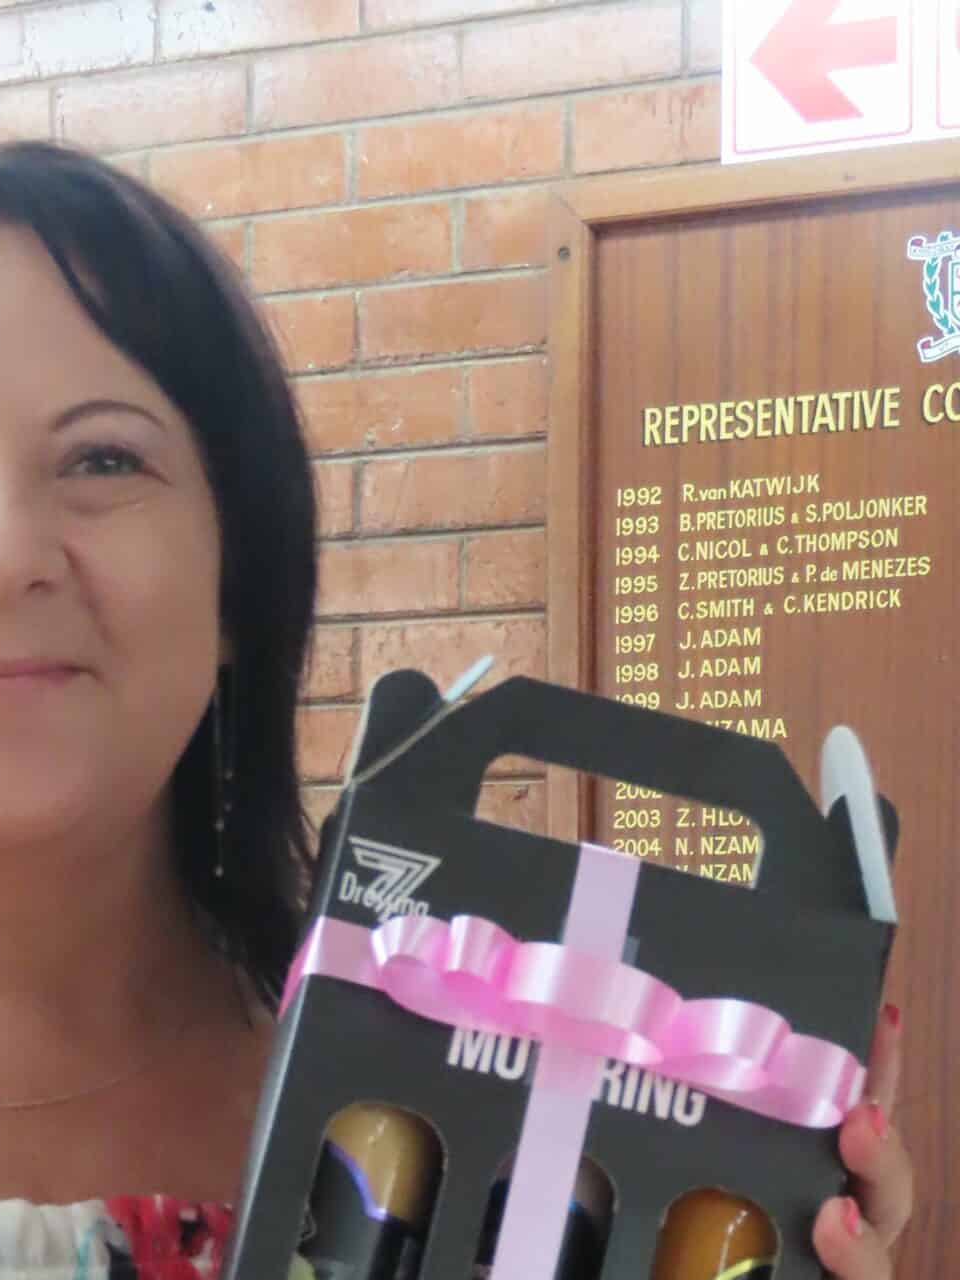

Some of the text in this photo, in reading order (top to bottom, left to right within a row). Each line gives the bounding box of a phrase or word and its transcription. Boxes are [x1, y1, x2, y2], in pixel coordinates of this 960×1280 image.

[643, 387, 901, 447] REPRESENTATIVE
[617, 487, 662, 506] 1992
[615, 516, 660, 536] 1993
[615, 546, 660, 566] 1994
[615, 576, 658, 595] 1995
[843, 556, 931, 581] MENEZES
[615, 604, 659, 625] 1996
[615, 634, 656, 654] 1997
[615, 663, 659, 683] 1998
[613, 809, 661, 829] 2003
[613, 837, 662, 856] 2004
